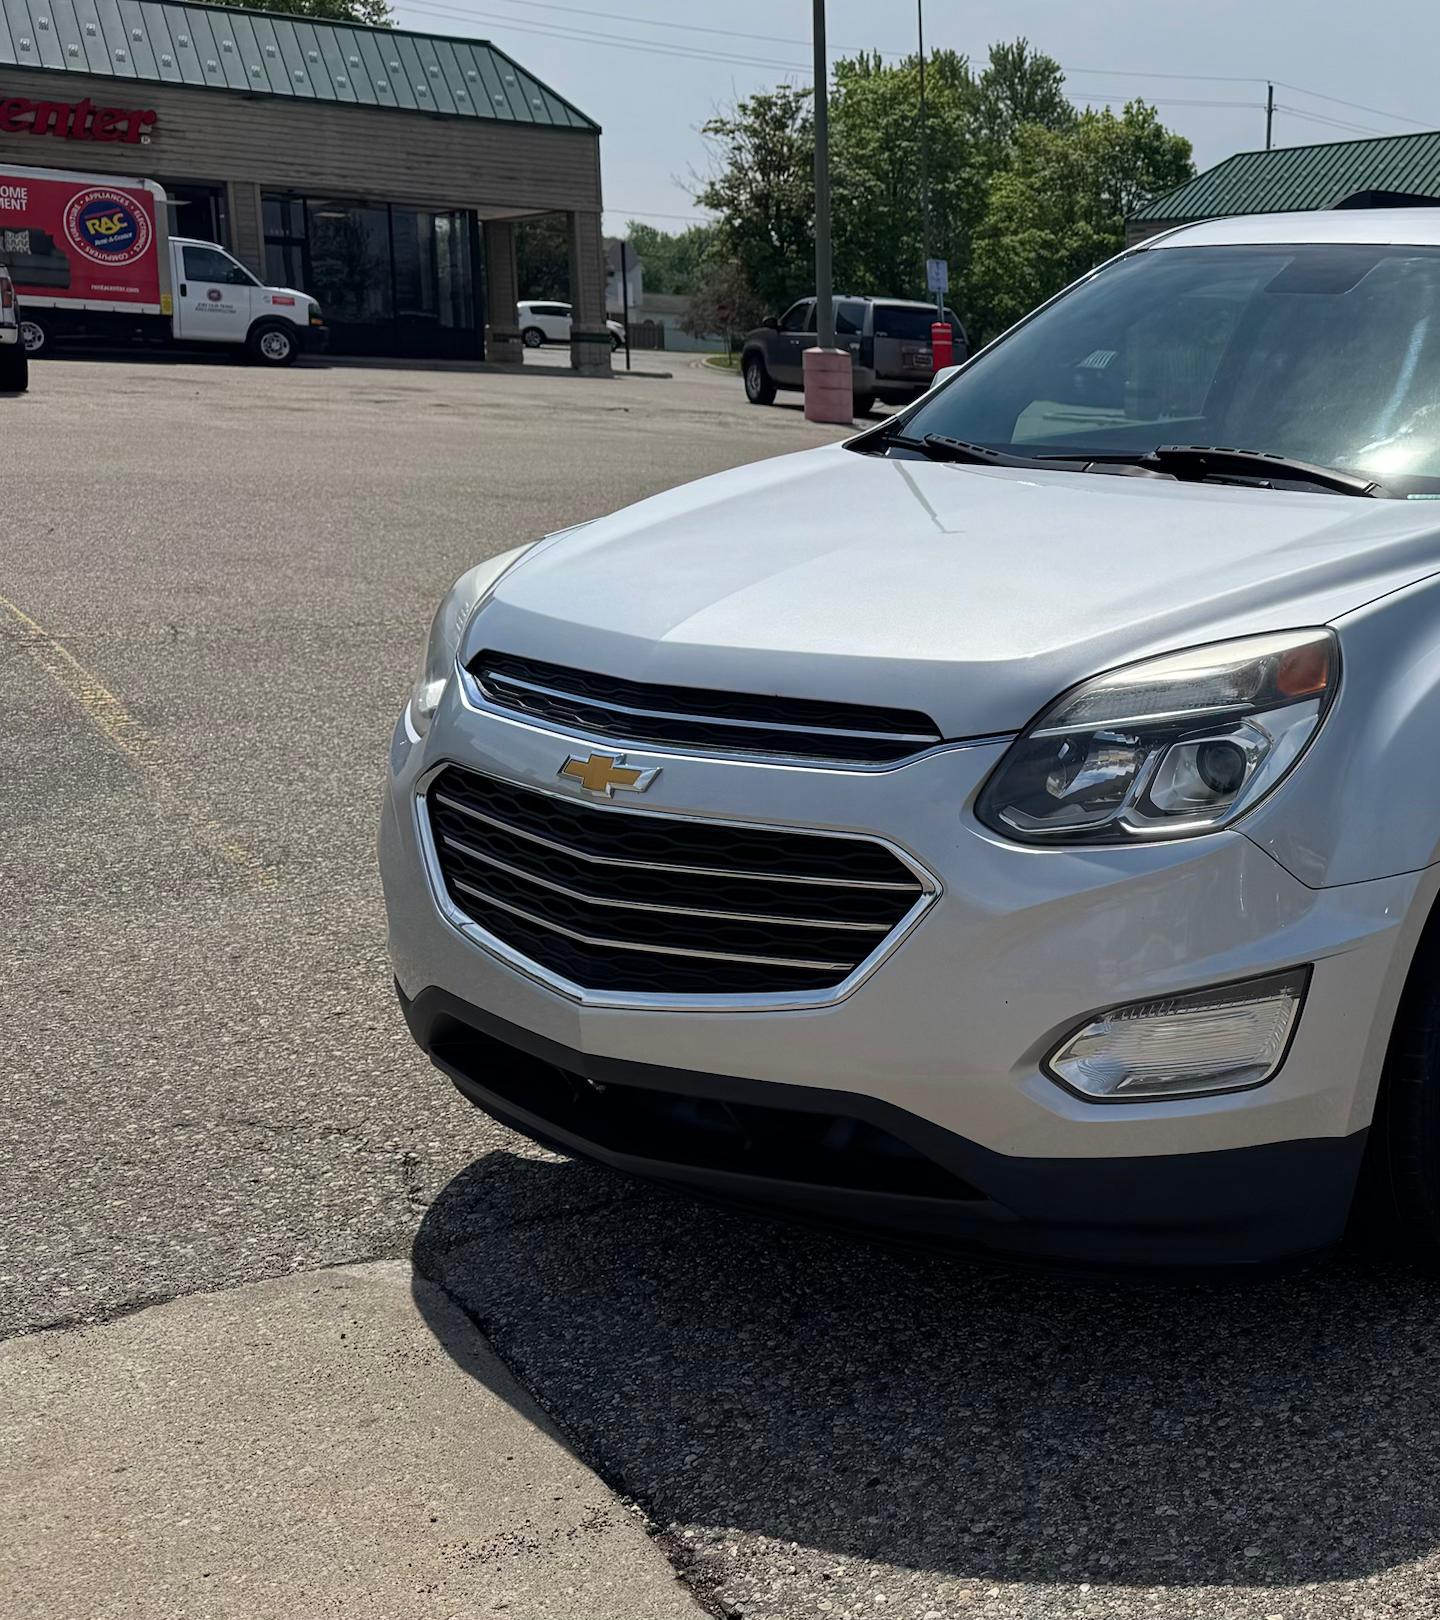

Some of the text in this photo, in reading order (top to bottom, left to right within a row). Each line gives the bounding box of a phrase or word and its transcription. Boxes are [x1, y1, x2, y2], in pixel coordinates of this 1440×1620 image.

[0, 97, 157, 144] enter
[85, 192, 130, 207] APPLIANCES
[69, 204, 81, 242] FURNITURE
[85, 213, 128, 235] RAC
[133, 210, 147, 253] ELECTRONICS
[86, 245, 129, 262] COMPUTERS
